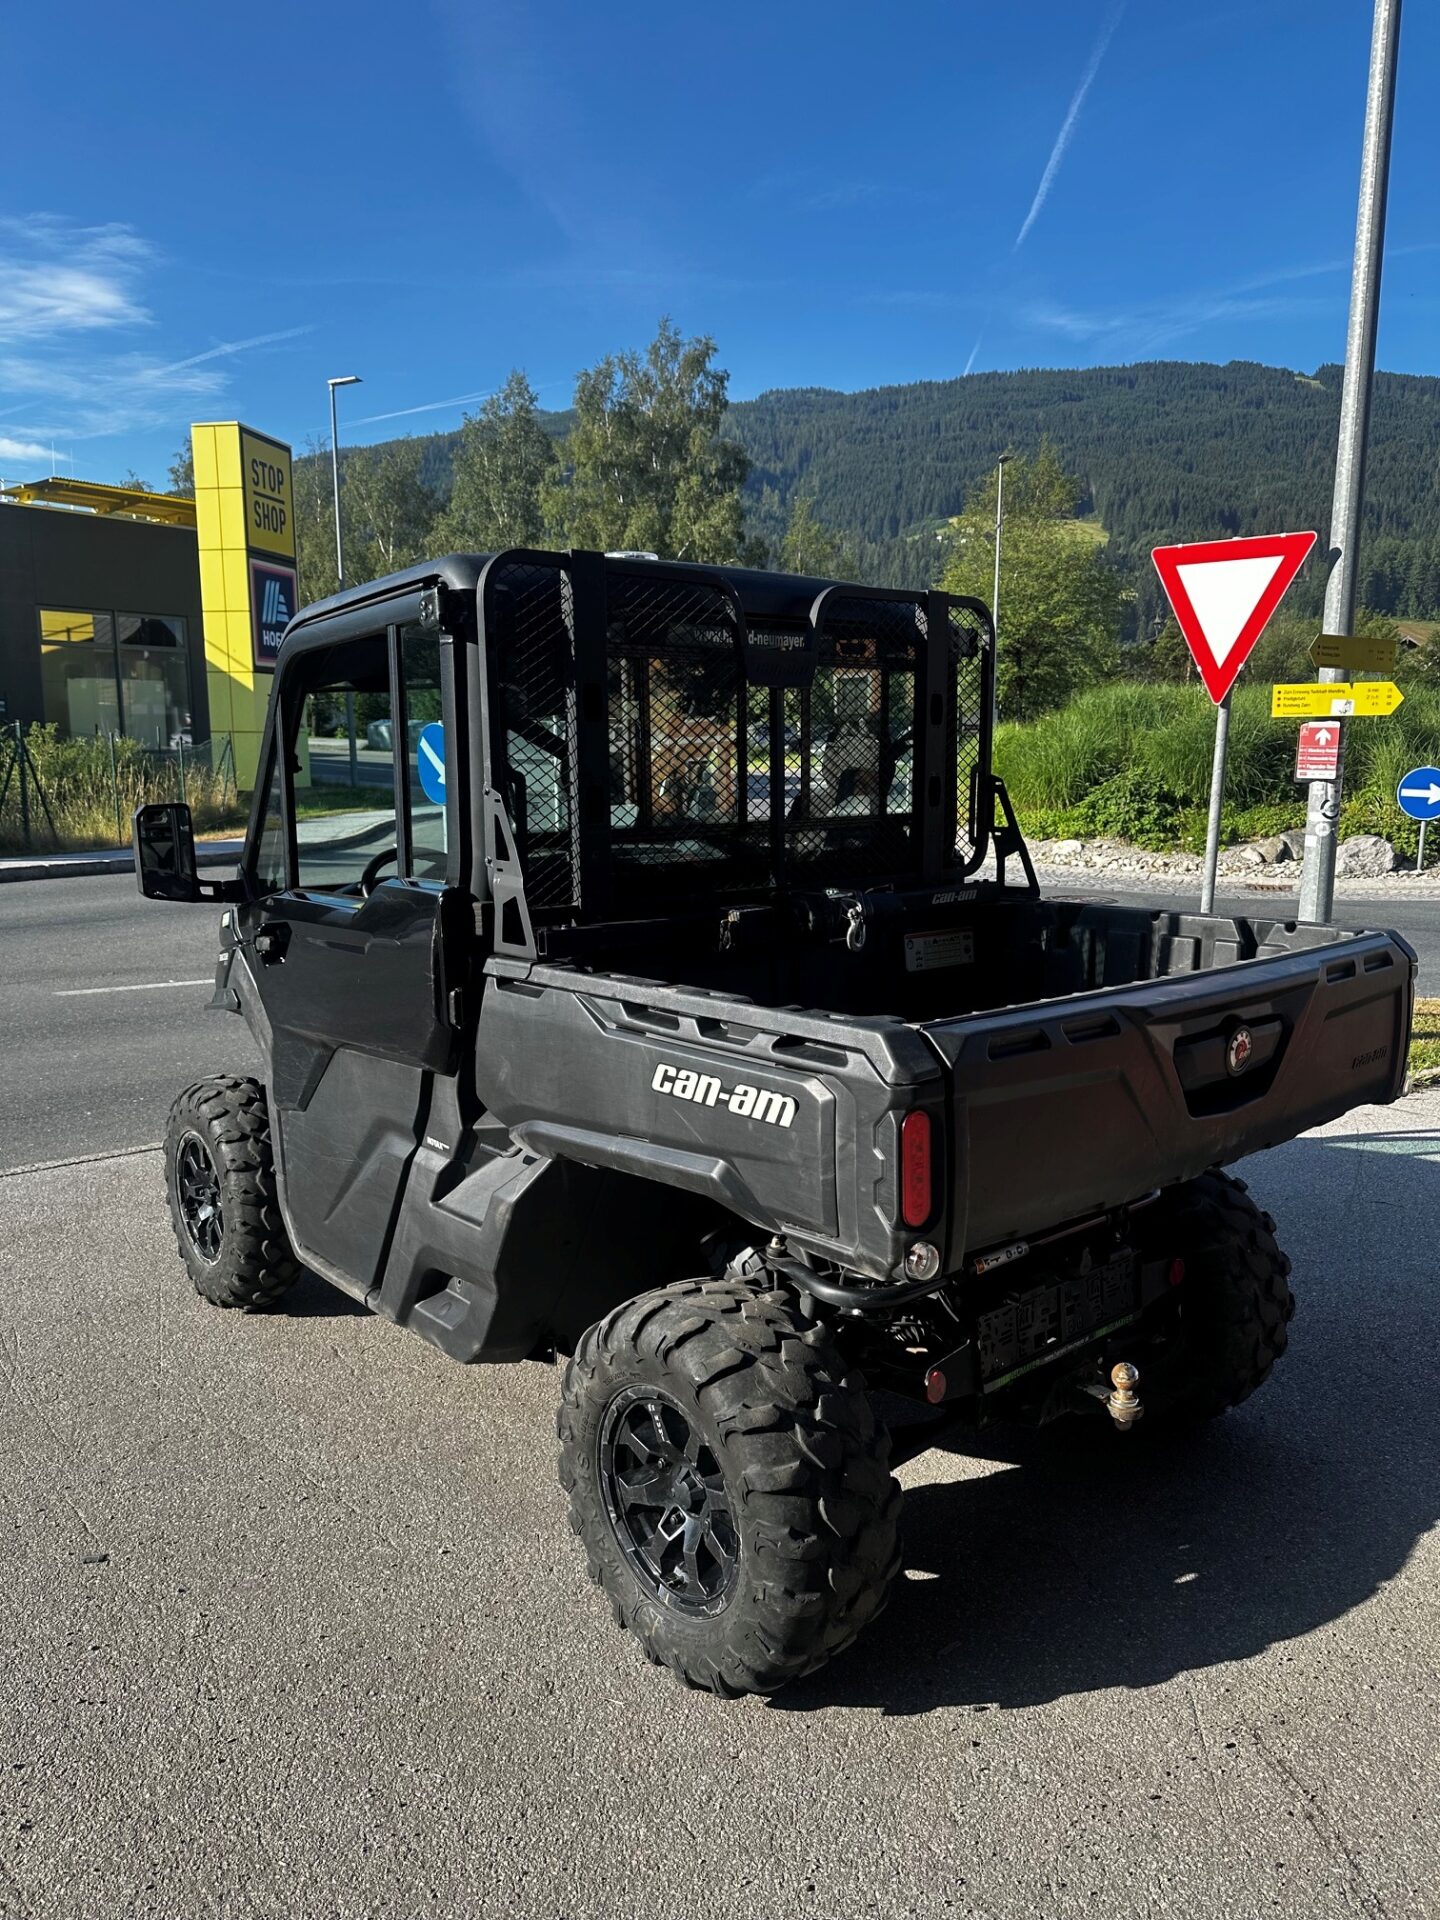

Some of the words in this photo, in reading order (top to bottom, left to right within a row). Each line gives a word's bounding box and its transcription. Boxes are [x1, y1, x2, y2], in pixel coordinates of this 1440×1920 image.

[251, 458, 285, 495] STOP
[254, 500, 287, 535] SHOP
[262, 629, 283, 647] HOF
[931, 889, 978, 904] can-am
[651, 1062, 797, 1129] can-am
